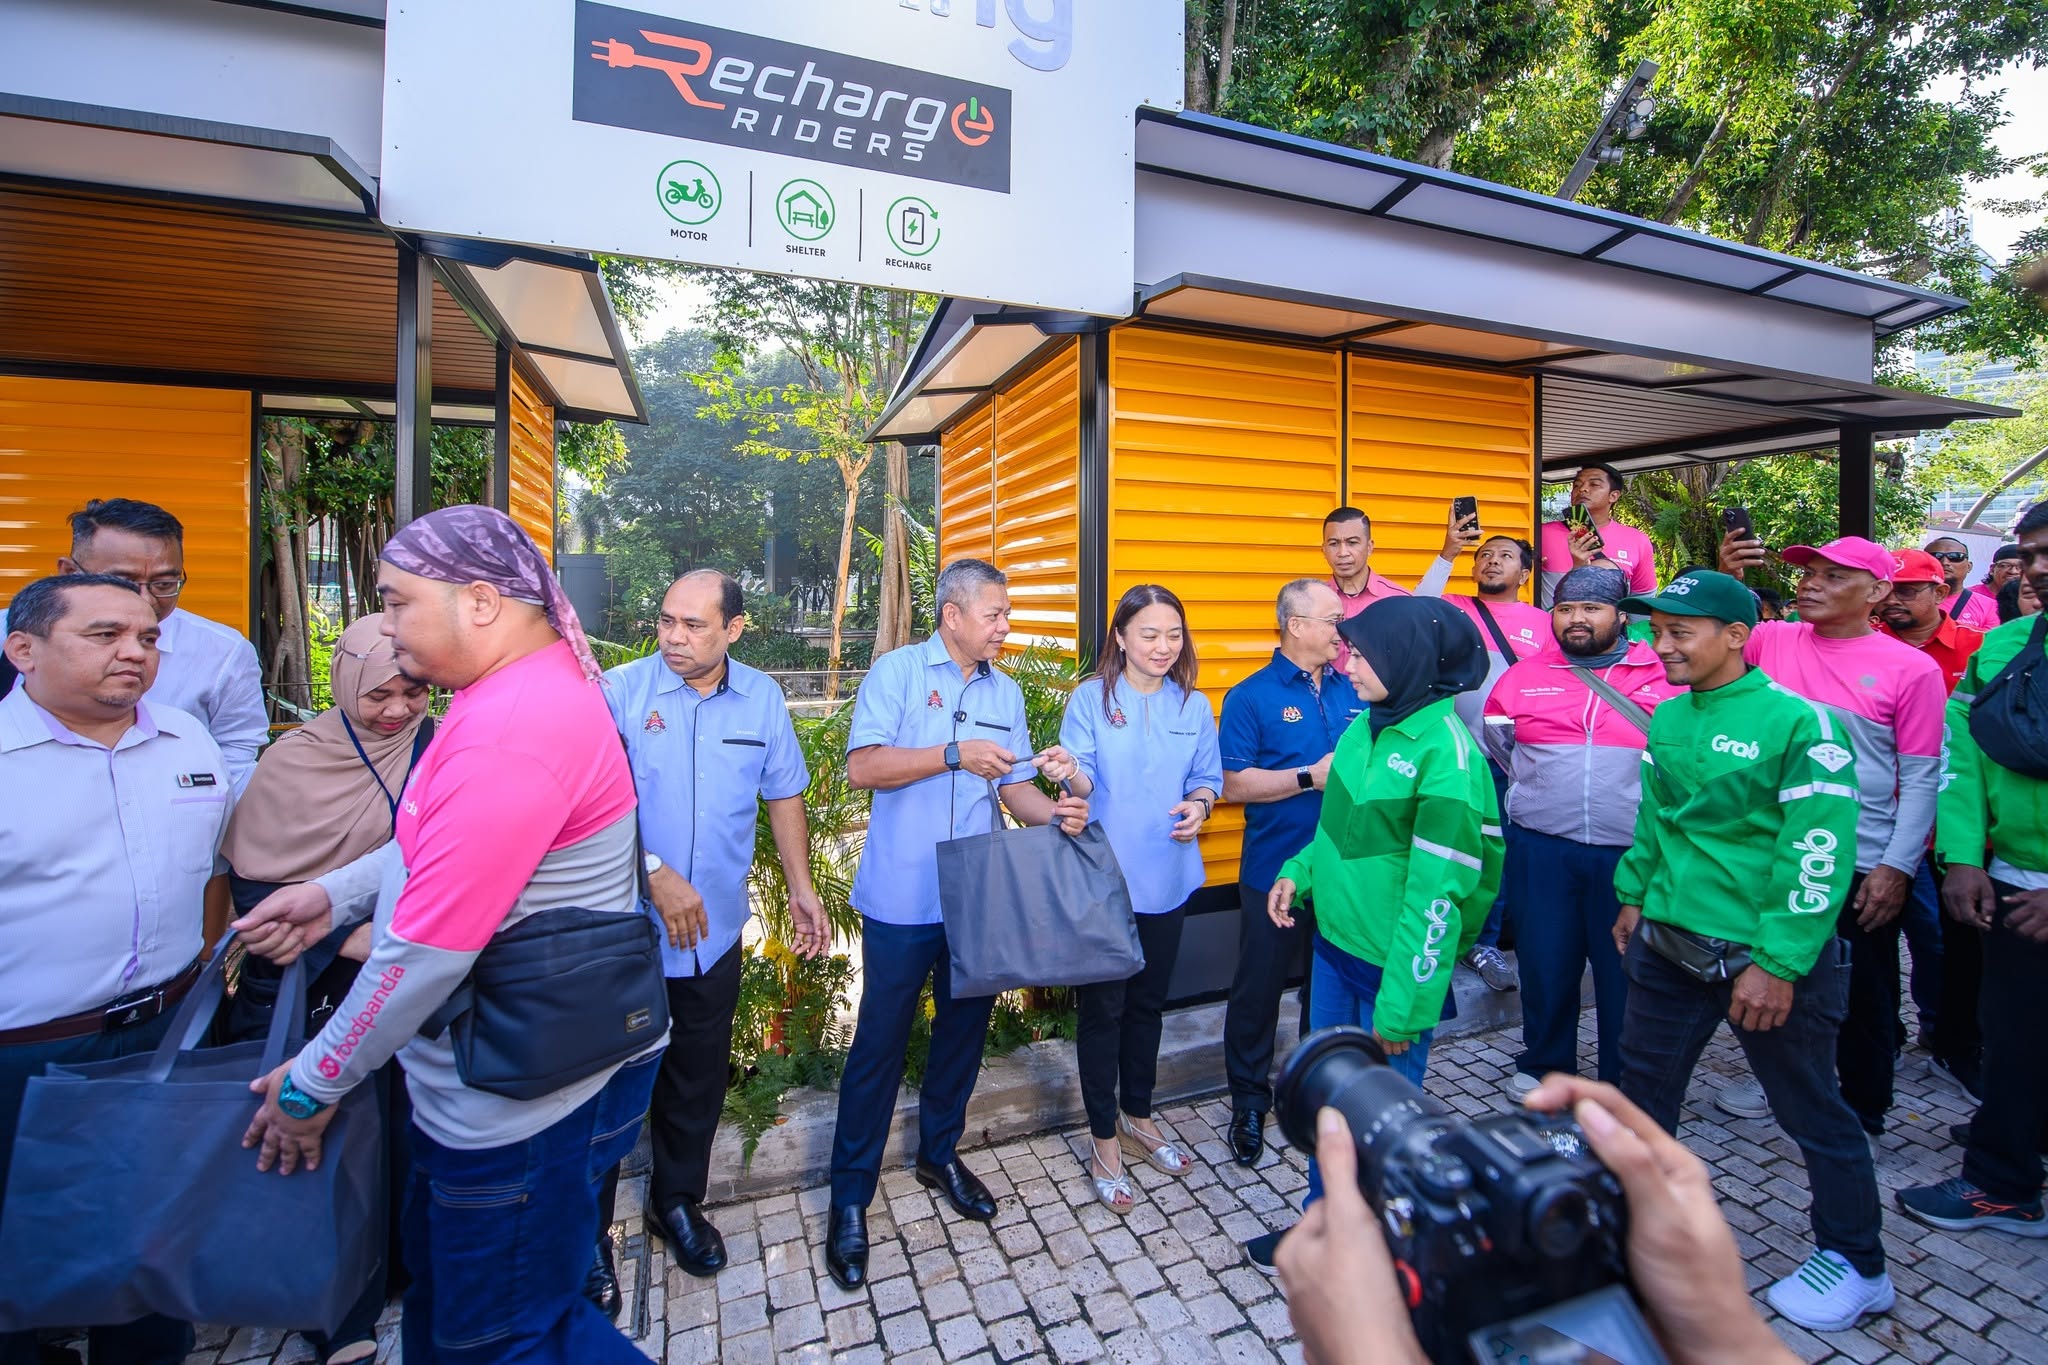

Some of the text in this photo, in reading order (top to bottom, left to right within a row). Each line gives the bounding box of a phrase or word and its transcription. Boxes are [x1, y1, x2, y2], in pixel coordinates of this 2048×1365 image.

[638, 29, 994, 146] Recharge
[731, 106, 925, 162] RIDERS
[670, 228, 708, 242] MOTOR
[785, 244, 826, 258] SHELTER
[885, 257, 932, 272] RECHARGE
[1387, 752, 1418, 778] Grab
[1711, 734, 1760, 760] Grab
[1787, 827, 1838, 914] Grab
[1412, 898, 1451, 984] Grab
[333, 965, 406, 1062] foodpanda
